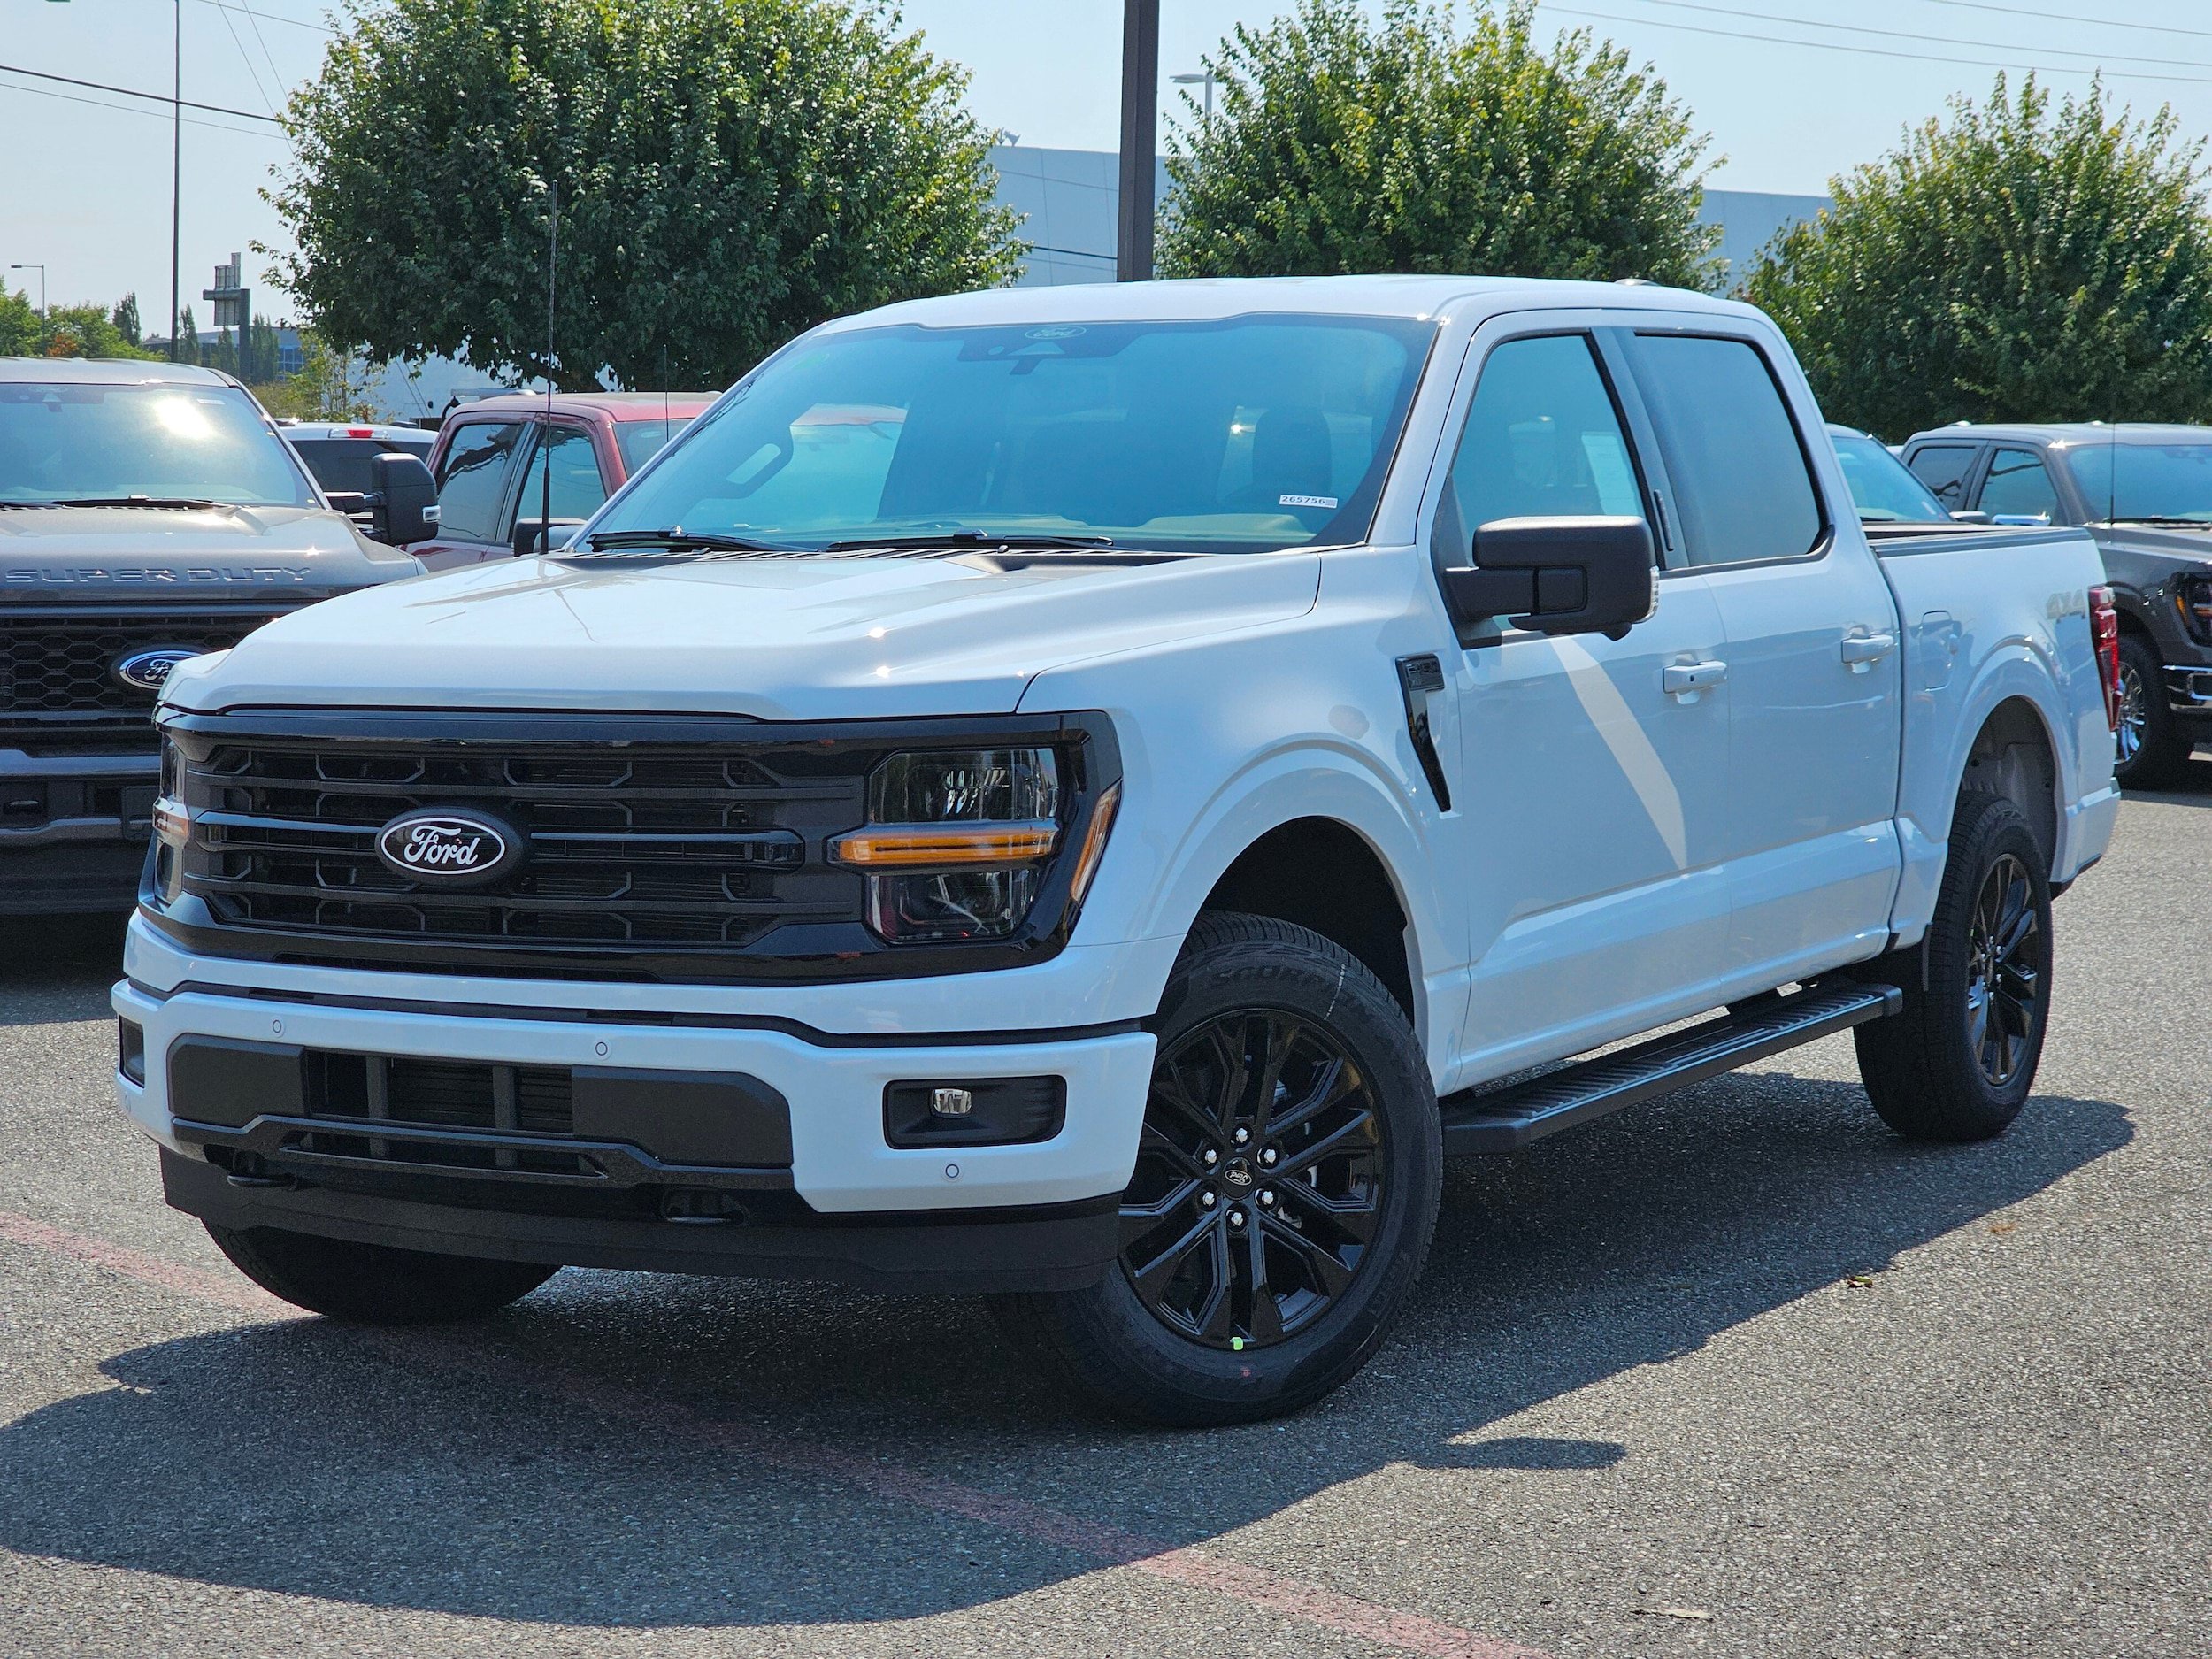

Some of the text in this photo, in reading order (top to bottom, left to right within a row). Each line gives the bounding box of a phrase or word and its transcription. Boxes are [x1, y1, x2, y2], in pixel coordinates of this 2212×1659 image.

[1281, 495, 1325, 504] 265756
[5, 568, 311, 583] SUPER DUTY
[404, 825, 480, 865] Ford
[1229, 1171, 1248, 1183] Ford
